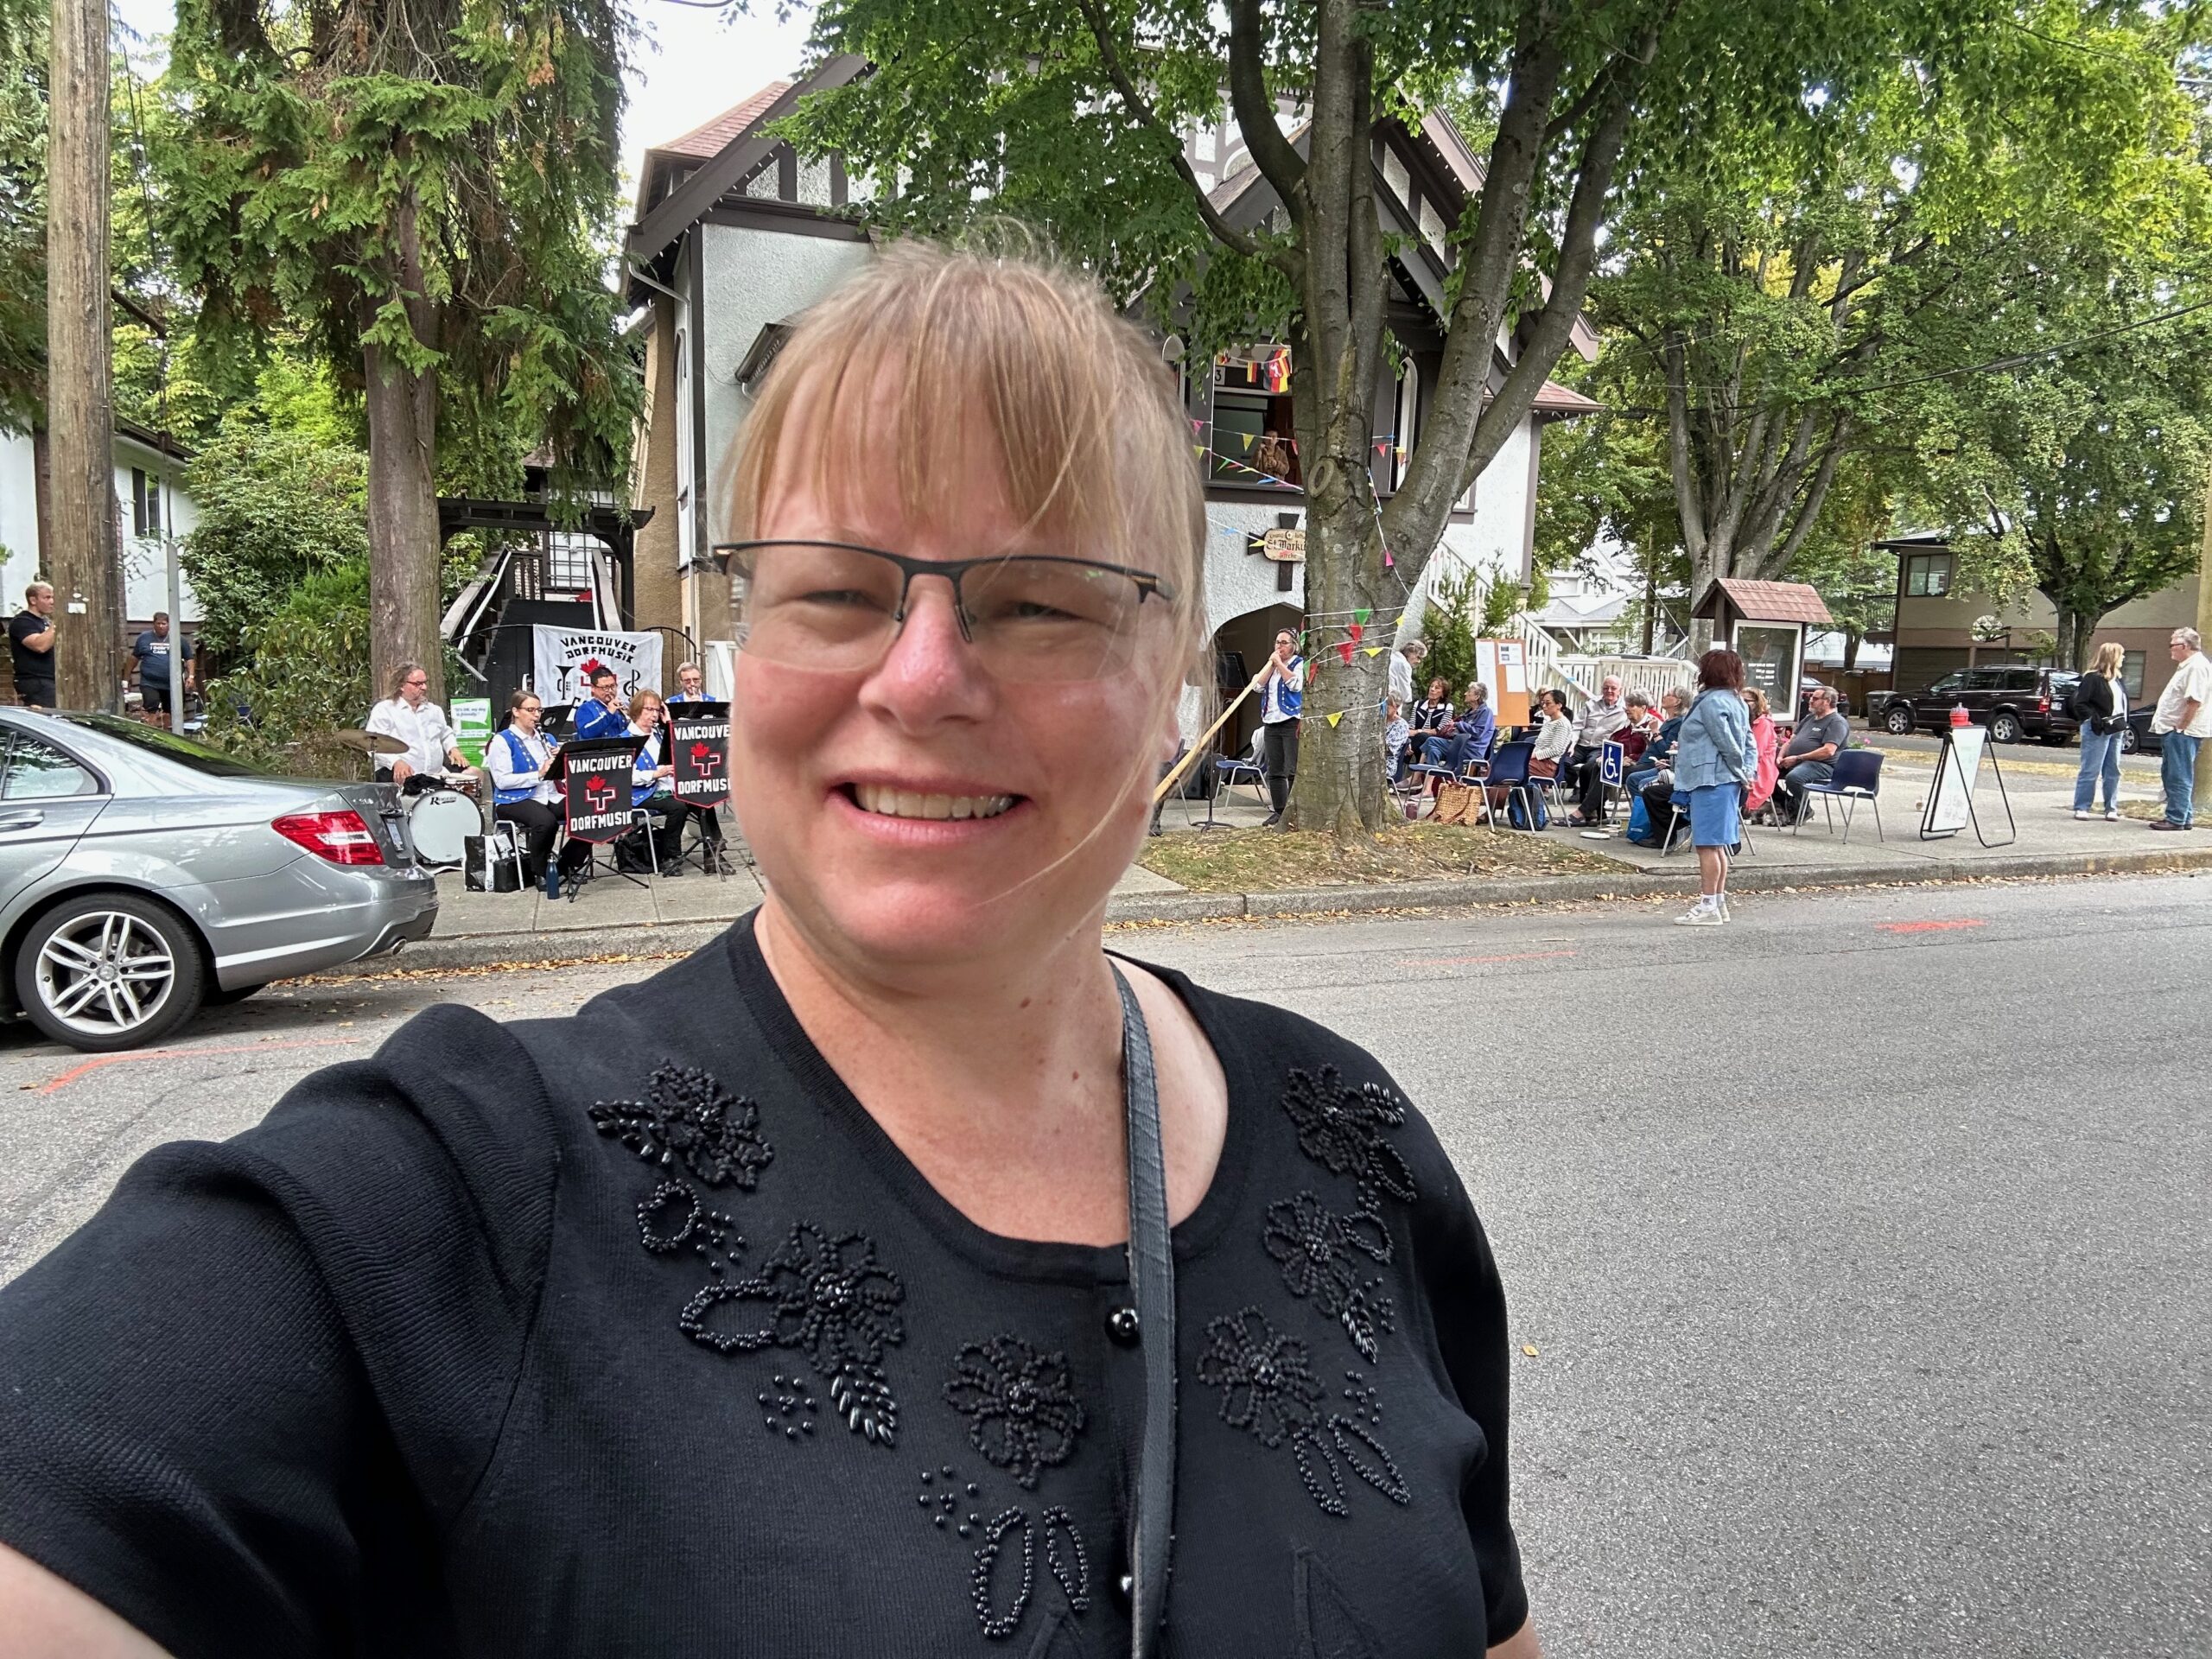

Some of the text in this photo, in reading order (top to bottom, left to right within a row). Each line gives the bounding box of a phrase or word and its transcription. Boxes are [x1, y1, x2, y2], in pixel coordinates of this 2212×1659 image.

[1278, 539, 1306, 551] Marku
[560, 636, 637, 654] VANCOUVER
[674, 724, 731, 741] VANCOUVE
[568, 754, 632, 774] VANCOUVER
[677, 778, 731, 795] DORFMUSI
[570, 810, 632, 831] DORFMUSIK
